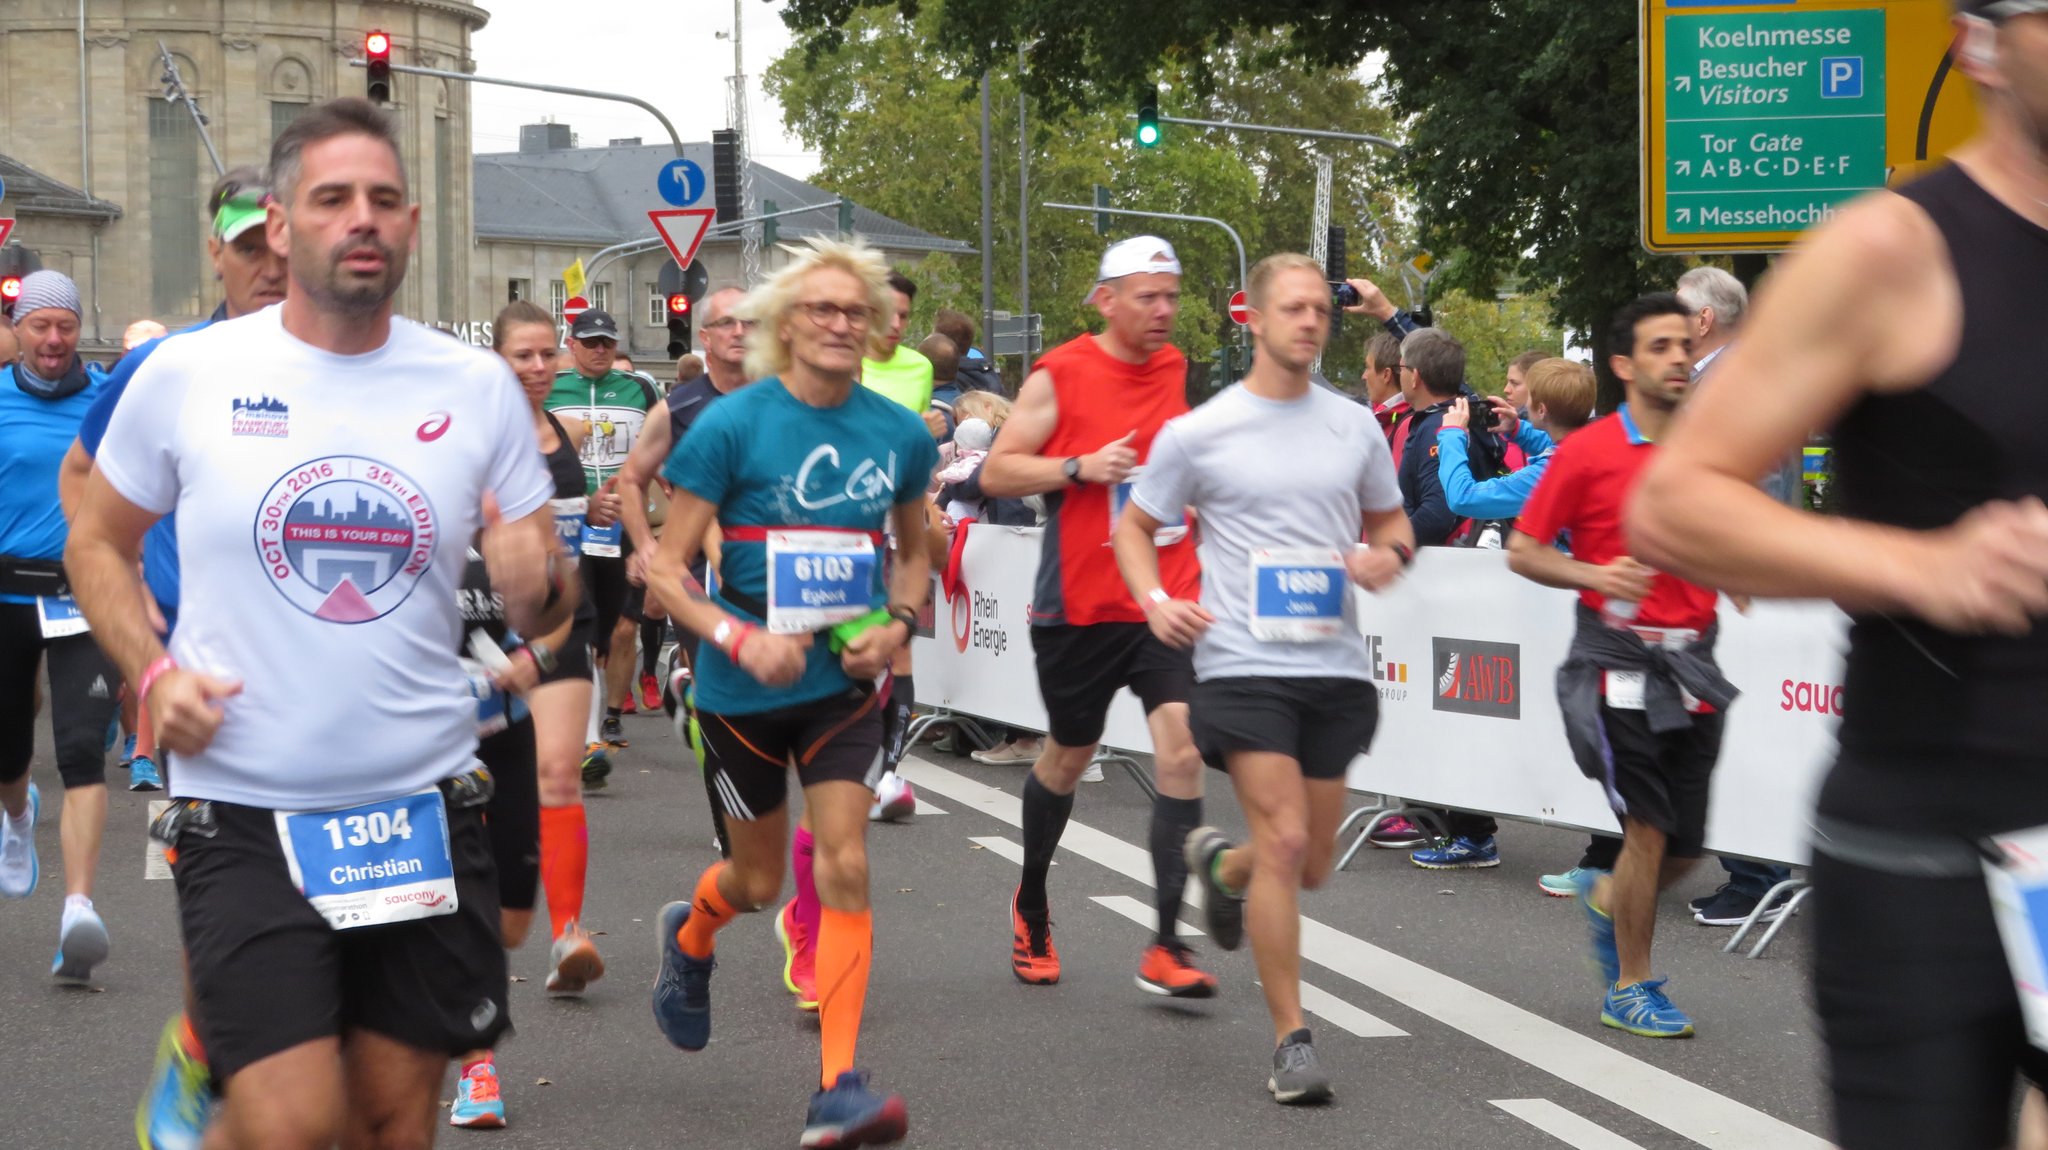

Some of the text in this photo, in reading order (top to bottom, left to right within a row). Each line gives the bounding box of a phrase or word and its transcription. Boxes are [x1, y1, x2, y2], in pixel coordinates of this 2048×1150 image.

[1698, 24, 1851, 48] Koelnmesse
[1698, 56, 1808, 80] Besucher
[1831, 62, 1853, 93] P
[1699, 84, 1790, 105] Visitors
[1700, 132, 1804, 154] Tor Gate
[262, 537, 290, 580] OCT
[287, 462, 334, 493] 2016
[404, 494, 434, 576] EDITION
[291, 527, 410, 545] THIS IS YOUR DAY
[794, 554, 855, 583] 6103
[974, 590, 998, 620] Rhein
[974, 620, 1007, 657] Energie
[1463, 655, 1515, 705] AWB
[322, 807, 414, 851] 1304
[329, 857, 424, 886] Christian
[385, 889, 436, 905] saucony
